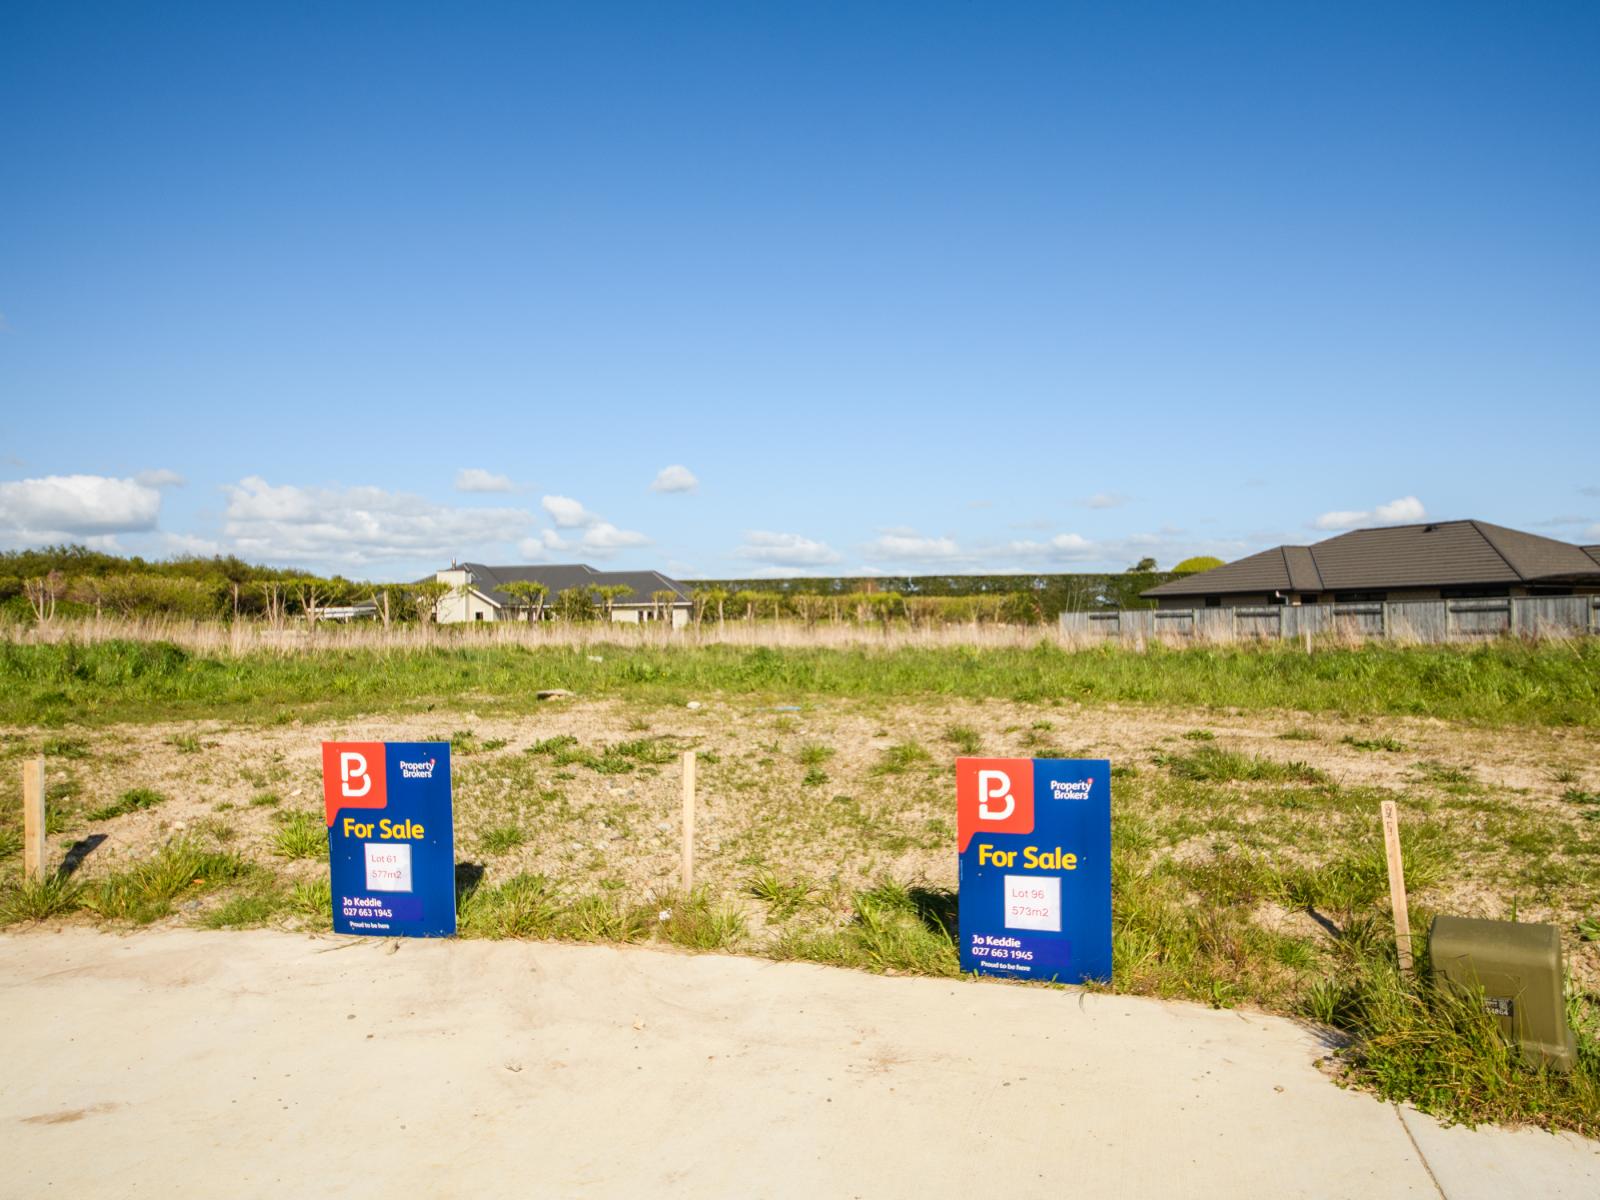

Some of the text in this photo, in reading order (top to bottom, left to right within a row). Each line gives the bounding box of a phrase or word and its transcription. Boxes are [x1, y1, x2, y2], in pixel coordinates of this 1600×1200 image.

[400, 760, 434, 772] Property
[340, 752, 371, 796] B
[403, 770, 432, 778] Brokers
[1051, 779, 1093, 792] Property
[978, 770, 1015, 820] B
[1054, 790, 1088, 800] Brokers
[344, 818, 424, 839] For Sale
[371, 855, 385, 863] Lot
[979, 844, 1077, 870] For Sale
[372, 870, 402, 879] 577m2
[1012, 888, 1045, 899] Lot 96
[343, 897, 382, 907] Jo Keddie
[344, 908, 392, 918] 027 663 1945
[1012, 906, 1049, 917] 573m2
[972, 935, 1021, 948] Jo Keddie
[972, 947, 1033, 960] 027 663 1945
